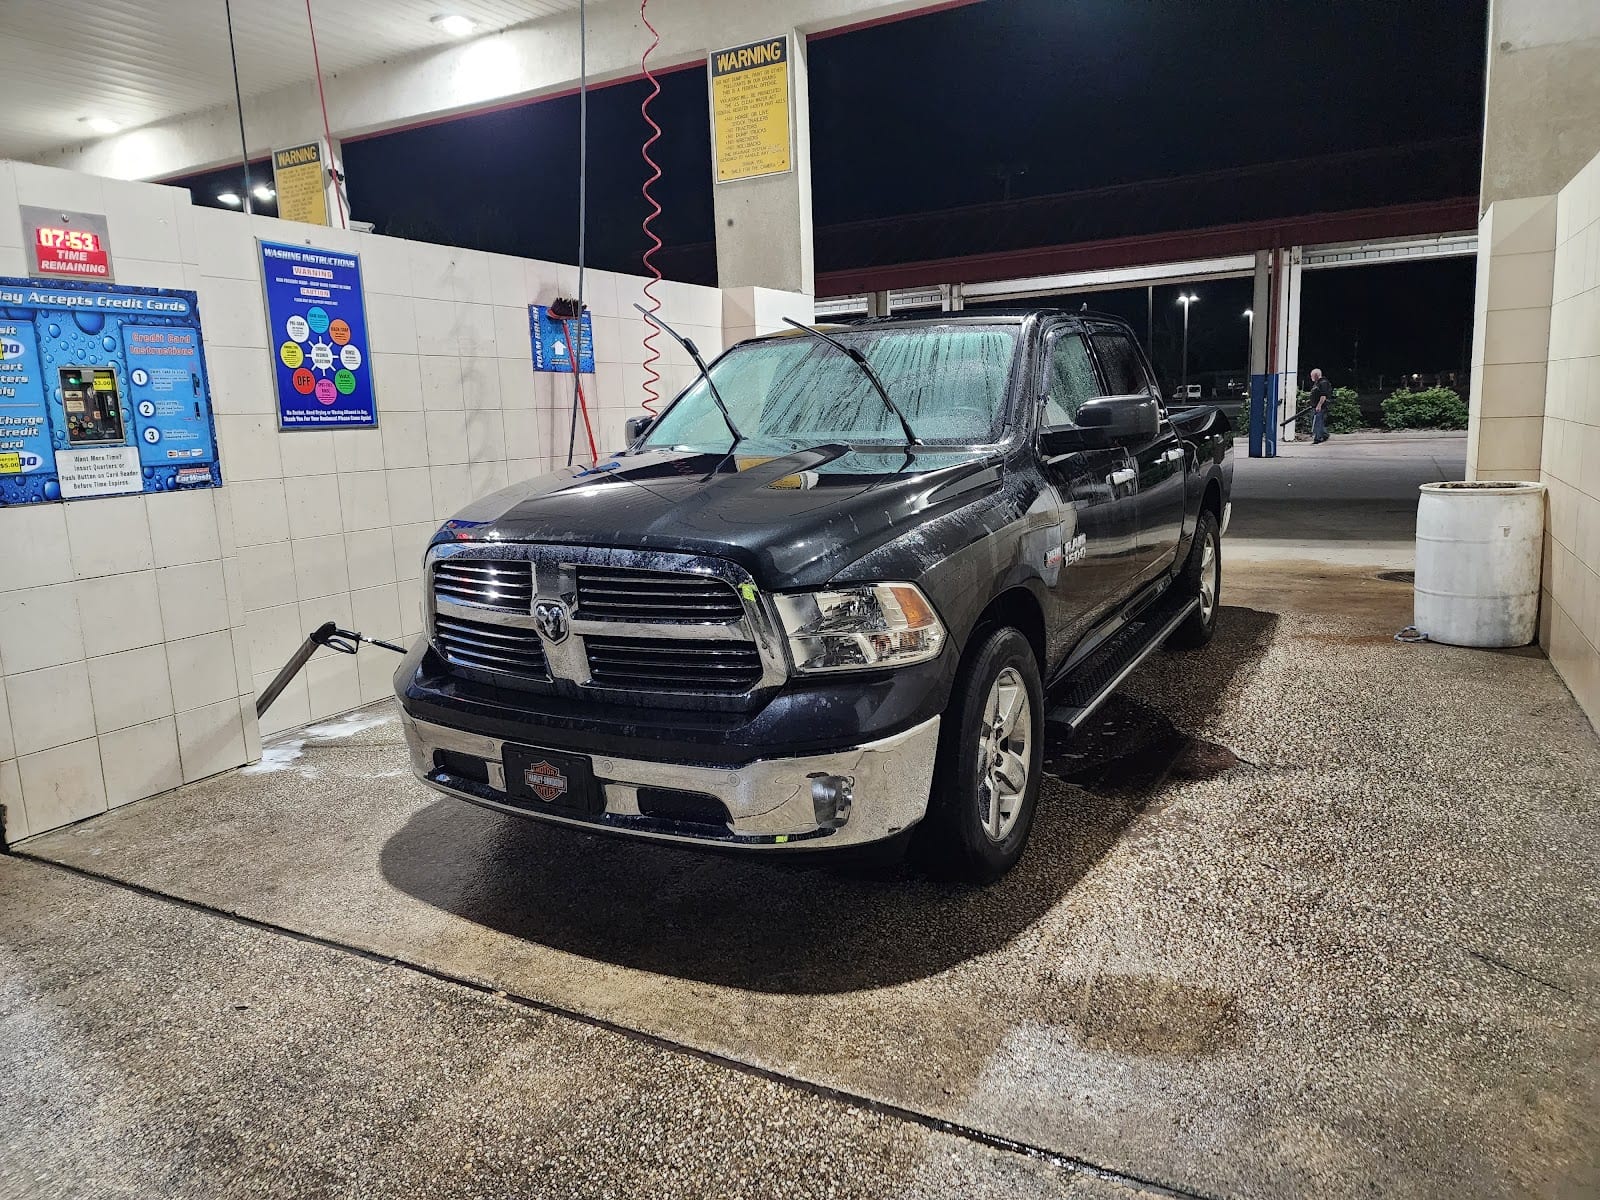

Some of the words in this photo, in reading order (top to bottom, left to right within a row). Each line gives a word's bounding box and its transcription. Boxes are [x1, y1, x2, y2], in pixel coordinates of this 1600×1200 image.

[716, 41, 781, 73] WARNING
[277, 146, 317, 166] WARNING
[40, 228, 94, 250] 07:53
[56, 250, 88, 261] TIME
[264, 248, 301, 261] WASHING
[302, 254, 355, 268] INSTRUCTIONS
[41, 260, 106, 273] REMAINING
[294, 267, 332, 279] WARNING
[301, 289, 329, 297] CAUTION
[0, 291, 23, 304] ay
[28, 292, 93, 308] Accepts
[97, 296, 143, 310] Credit
[146, 300, 186, 312] Cards
[533, 307, 541, 340] BRUSH
[132, 332, 164, 342] Credit
[168, 334, 191, 344] Card
[130, 345, 194, 356] Instructions
[297, 376, 310, 386] OFF
[144, 405, 150, 414] 2
[0, 416, 44, 425] Charge
[0, 428, 39, 436] Credit
[148, 432, 155, 440] 3
[1065, 533, 1086, 555] RAM
[1065, 547, 1086, 568] 1500
[535, 766, 555, 776] MOTOR
[538, 786, 555, 797] CYCLES
